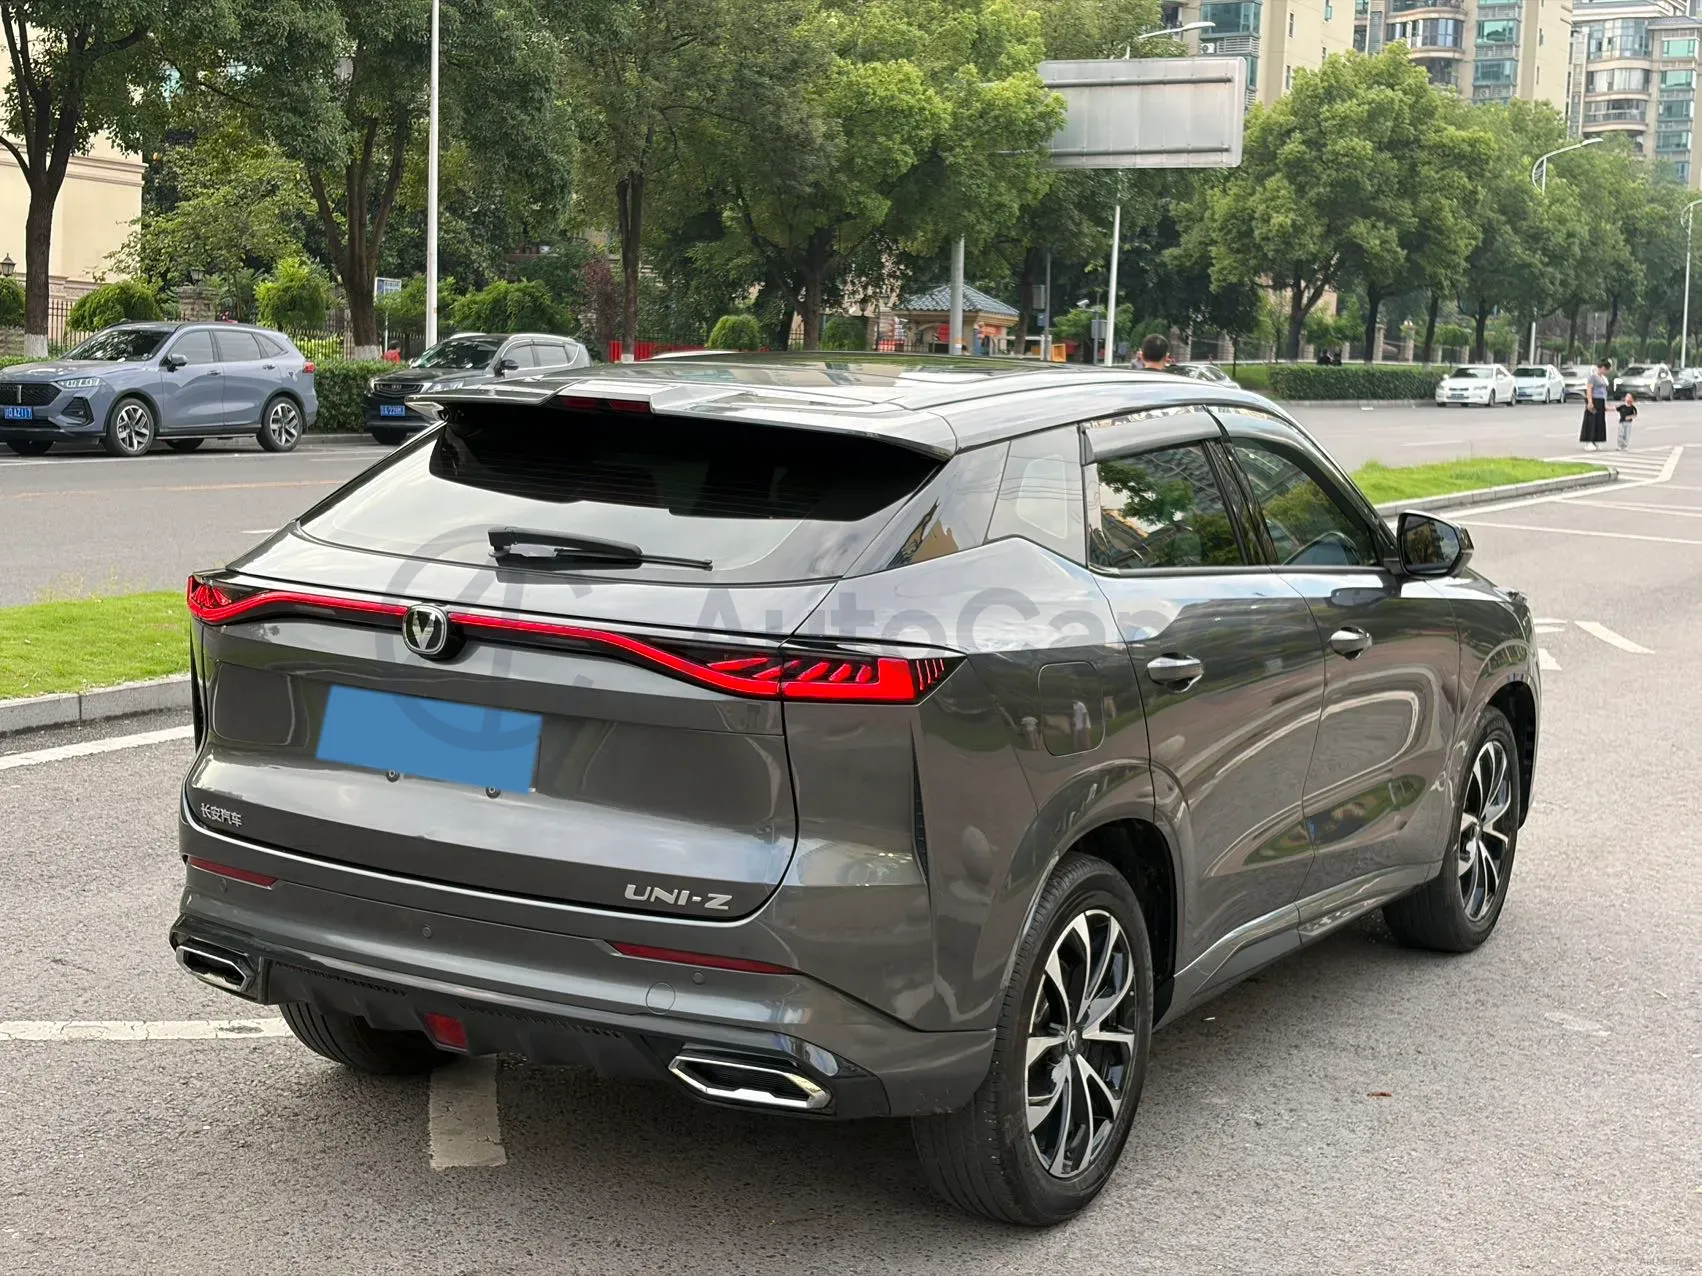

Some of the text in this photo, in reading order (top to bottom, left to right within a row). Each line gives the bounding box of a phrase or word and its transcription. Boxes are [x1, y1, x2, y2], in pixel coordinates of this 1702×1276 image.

[201, 803, 242, 827] 长安汽车
[624, 884, 733, 910] UNI-Z
